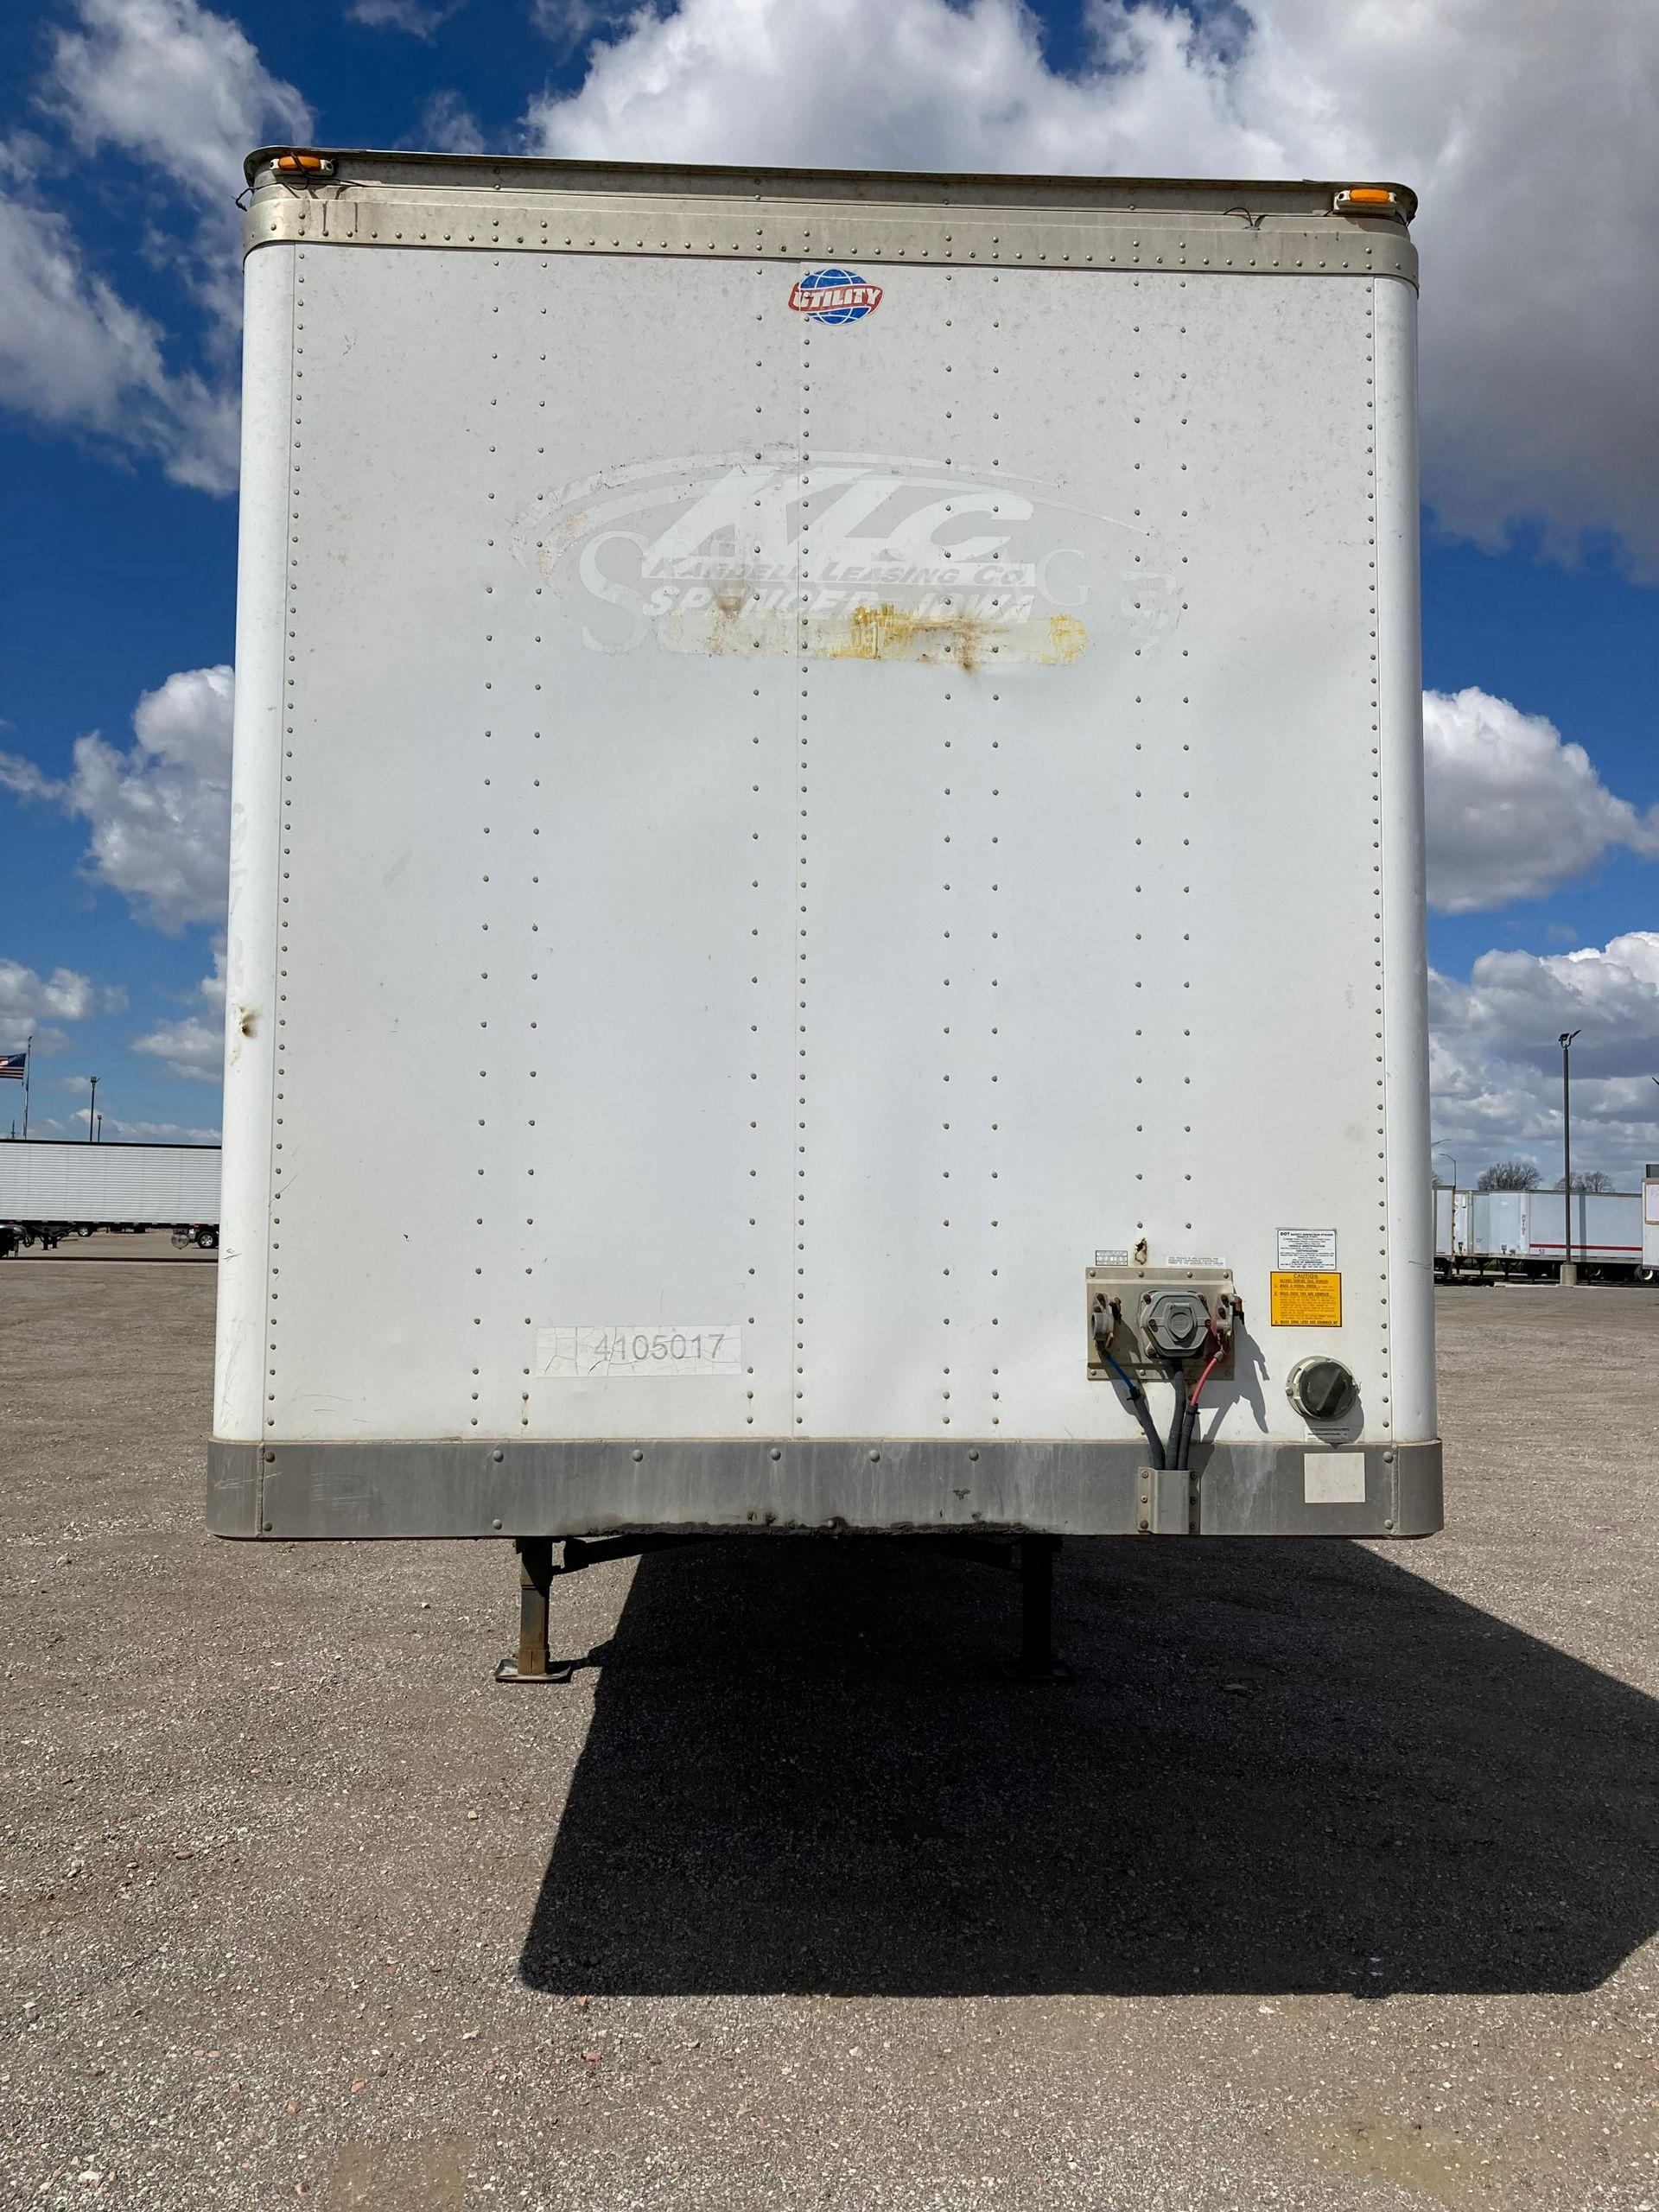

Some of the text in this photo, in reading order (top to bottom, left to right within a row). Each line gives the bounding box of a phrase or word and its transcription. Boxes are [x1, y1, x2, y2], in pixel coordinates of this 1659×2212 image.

[792, 288, 880, 308] UTILITY
[820, 561, 960, 584] LEASING
[594, 1334, 725, 1361] 4105017
